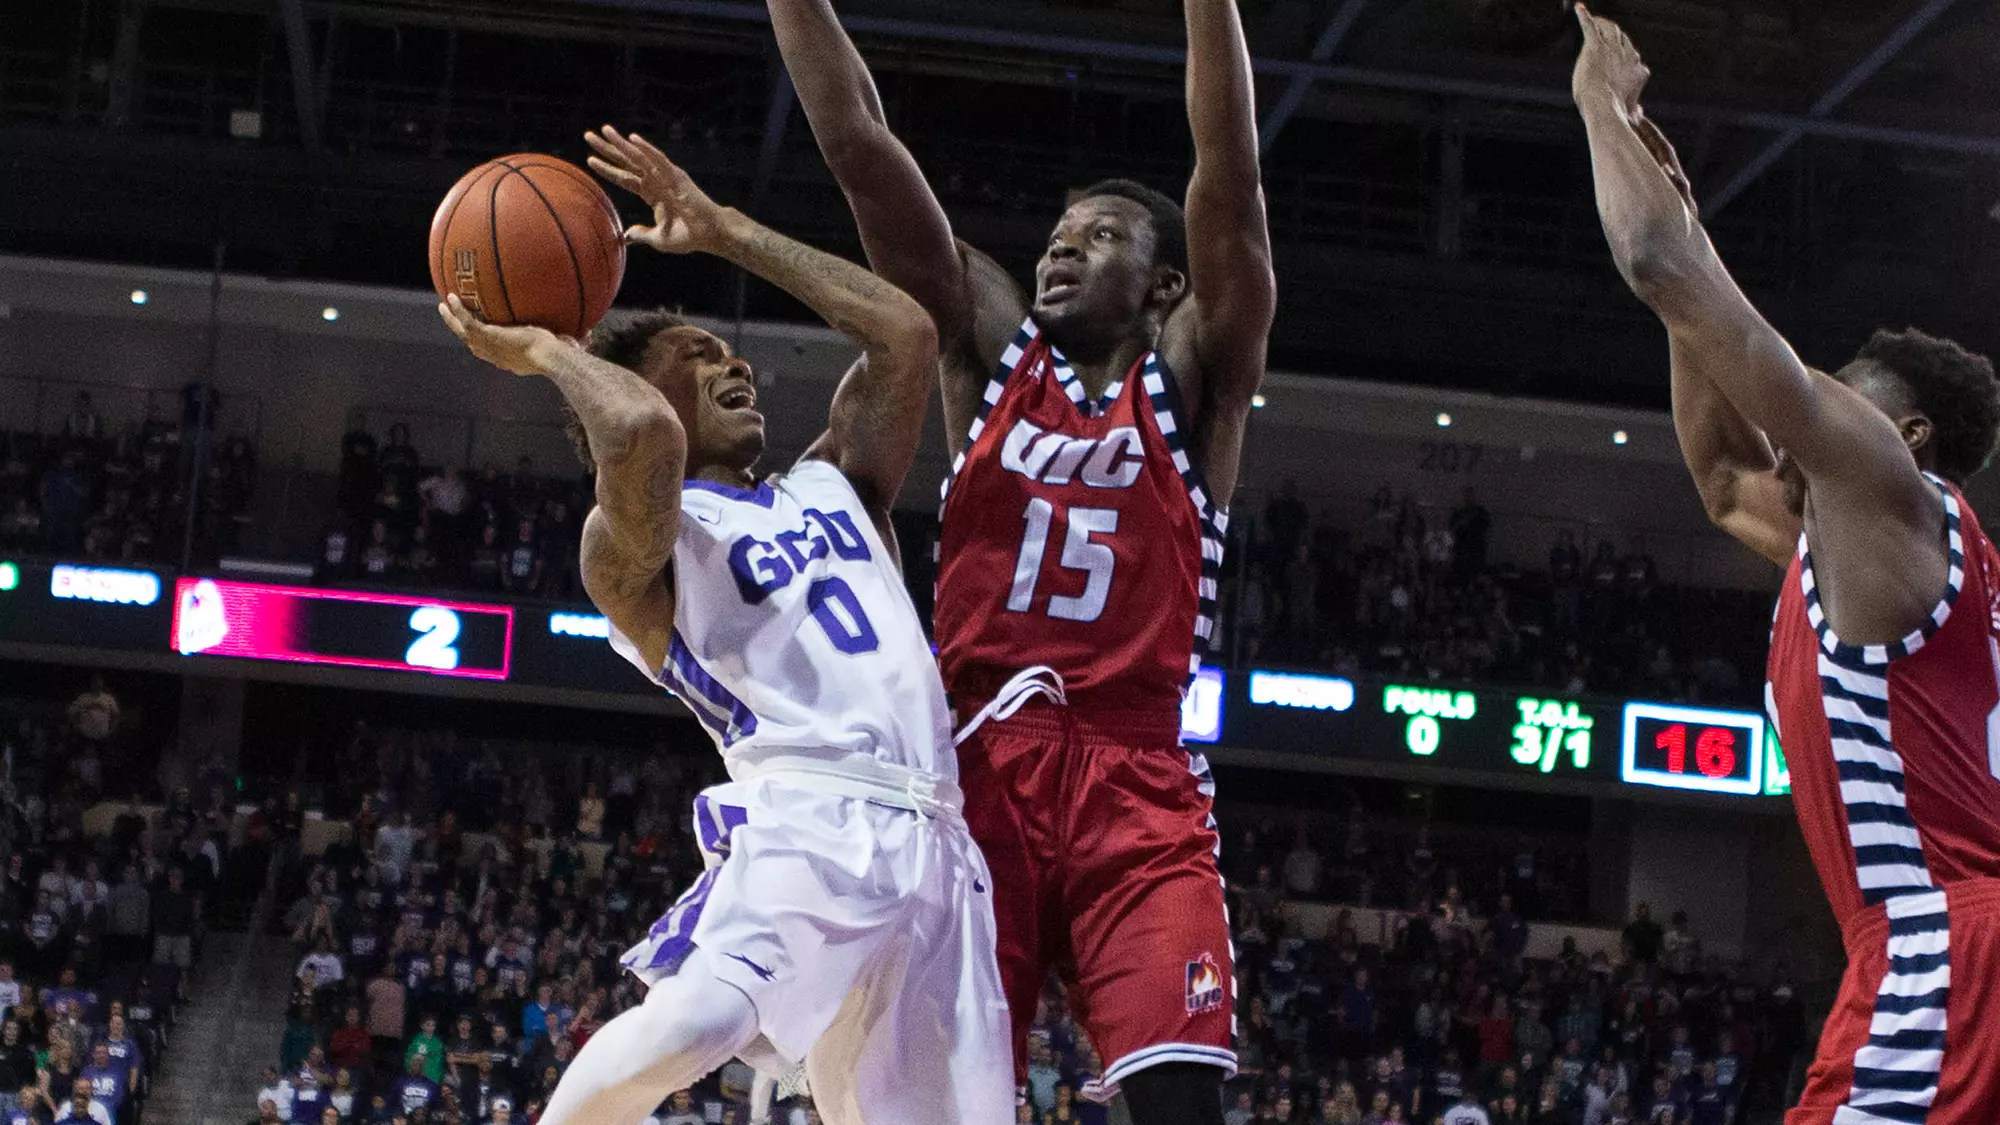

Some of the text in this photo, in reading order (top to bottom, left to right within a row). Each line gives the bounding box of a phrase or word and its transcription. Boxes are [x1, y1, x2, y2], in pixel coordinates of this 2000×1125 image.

[1001, 418, 1145, 488] UIC
[727, 508, 872, 606] GCU
[1006, 497, 1118, 622] 15
[405, 605, 460, 670] 2
[808, 576, 879, 655] 0
[1384, 685, 1476, 719] FOULS
[1406, 715, 1440, 755] 0
[1510, 724, 1592, 773] 3/1
[1655, 723, 1736, 779] 16
